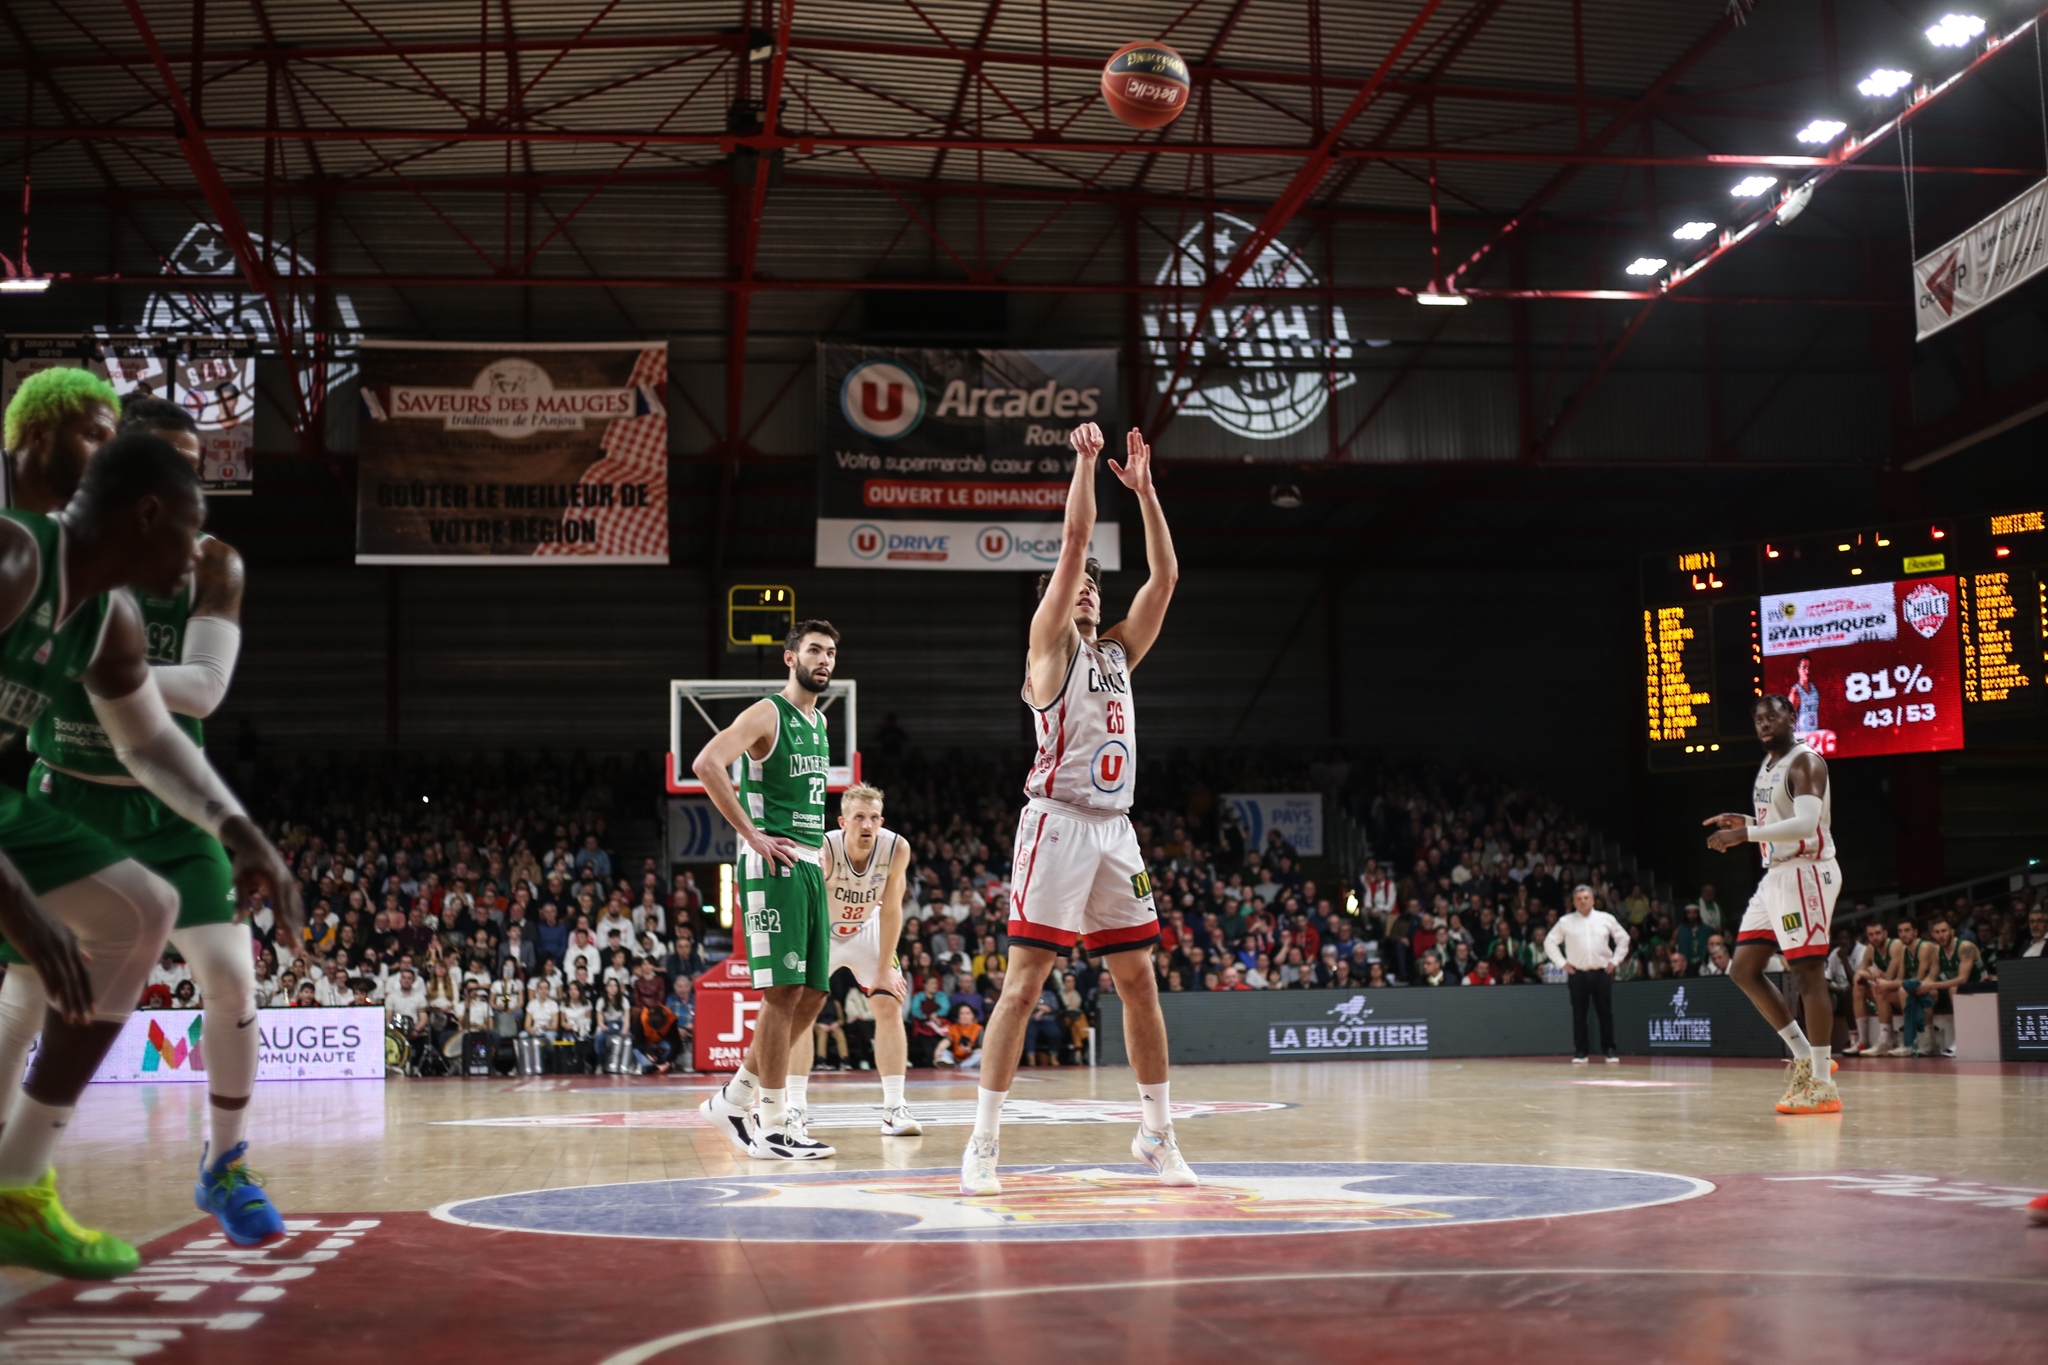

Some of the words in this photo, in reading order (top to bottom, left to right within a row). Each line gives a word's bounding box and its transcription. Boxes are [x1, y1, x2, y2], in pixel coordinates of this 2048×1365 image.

[1129, 81, 1179, 103] Betclic
[397, 391, 491, 413] SAVEURS
[499, 397, 529, 413] DES
[535, 391, 630, 413] MAUGES
[862, 381, 904, 421] U
[935, 379, 1101, 418] Arcades
[452, 413, 509, 426] traditions
[513, 413, 527, 426] de
[531, 414, 576, 428] l'Anjou
[835, 450, 881, 470] Votre
[884, 454, 986, 474] supermarché
[1038, 454, 1059, 473] de
[377, 480, 469, 508] GOÛTER
[475, 484, 498, 508] LE
[504, 483, 613, 508] MEILLEUR
[620, 483, 649, 508] DE
[868, 486, 944, 505] OUVERT
[947, 488, 969, 505] LE
[973, 487, 1068, 506] DIMANCHE
[429, 519, 501, 543] VOTRE
[509, 516, 596, 543] RÉGION
[857, 534, 877, 552] U
[888, 534, 950, 551] DRIVE
[985, 536, 1004, 553] U
[1845, 664, 1934, 703] 81%
[1107, 701, 1124, 734] 26
[1101, 755, 1123, 782] U
[808, 776, 825, 806] 22
[1271, 809, 1313, 824] PAYS
[1822, 871, 1832, 885] 12
[834, 886, 879, 905] CHOLET
[842, 906, 865, 921] 32
[258, 1025, 361, 1050] AUGES
[1269, 1028, 1301, 1048] LA
[1305, 1025, 1429, 1048] BLOTTIERE
[1649, 1018, 1662, 1041] LA
[1662, 1018, 1711, 1041] BLOTTIERE
[2016, 1015, 2038, 1041] LA
[708, 1047, 741, 1061] JEAN
